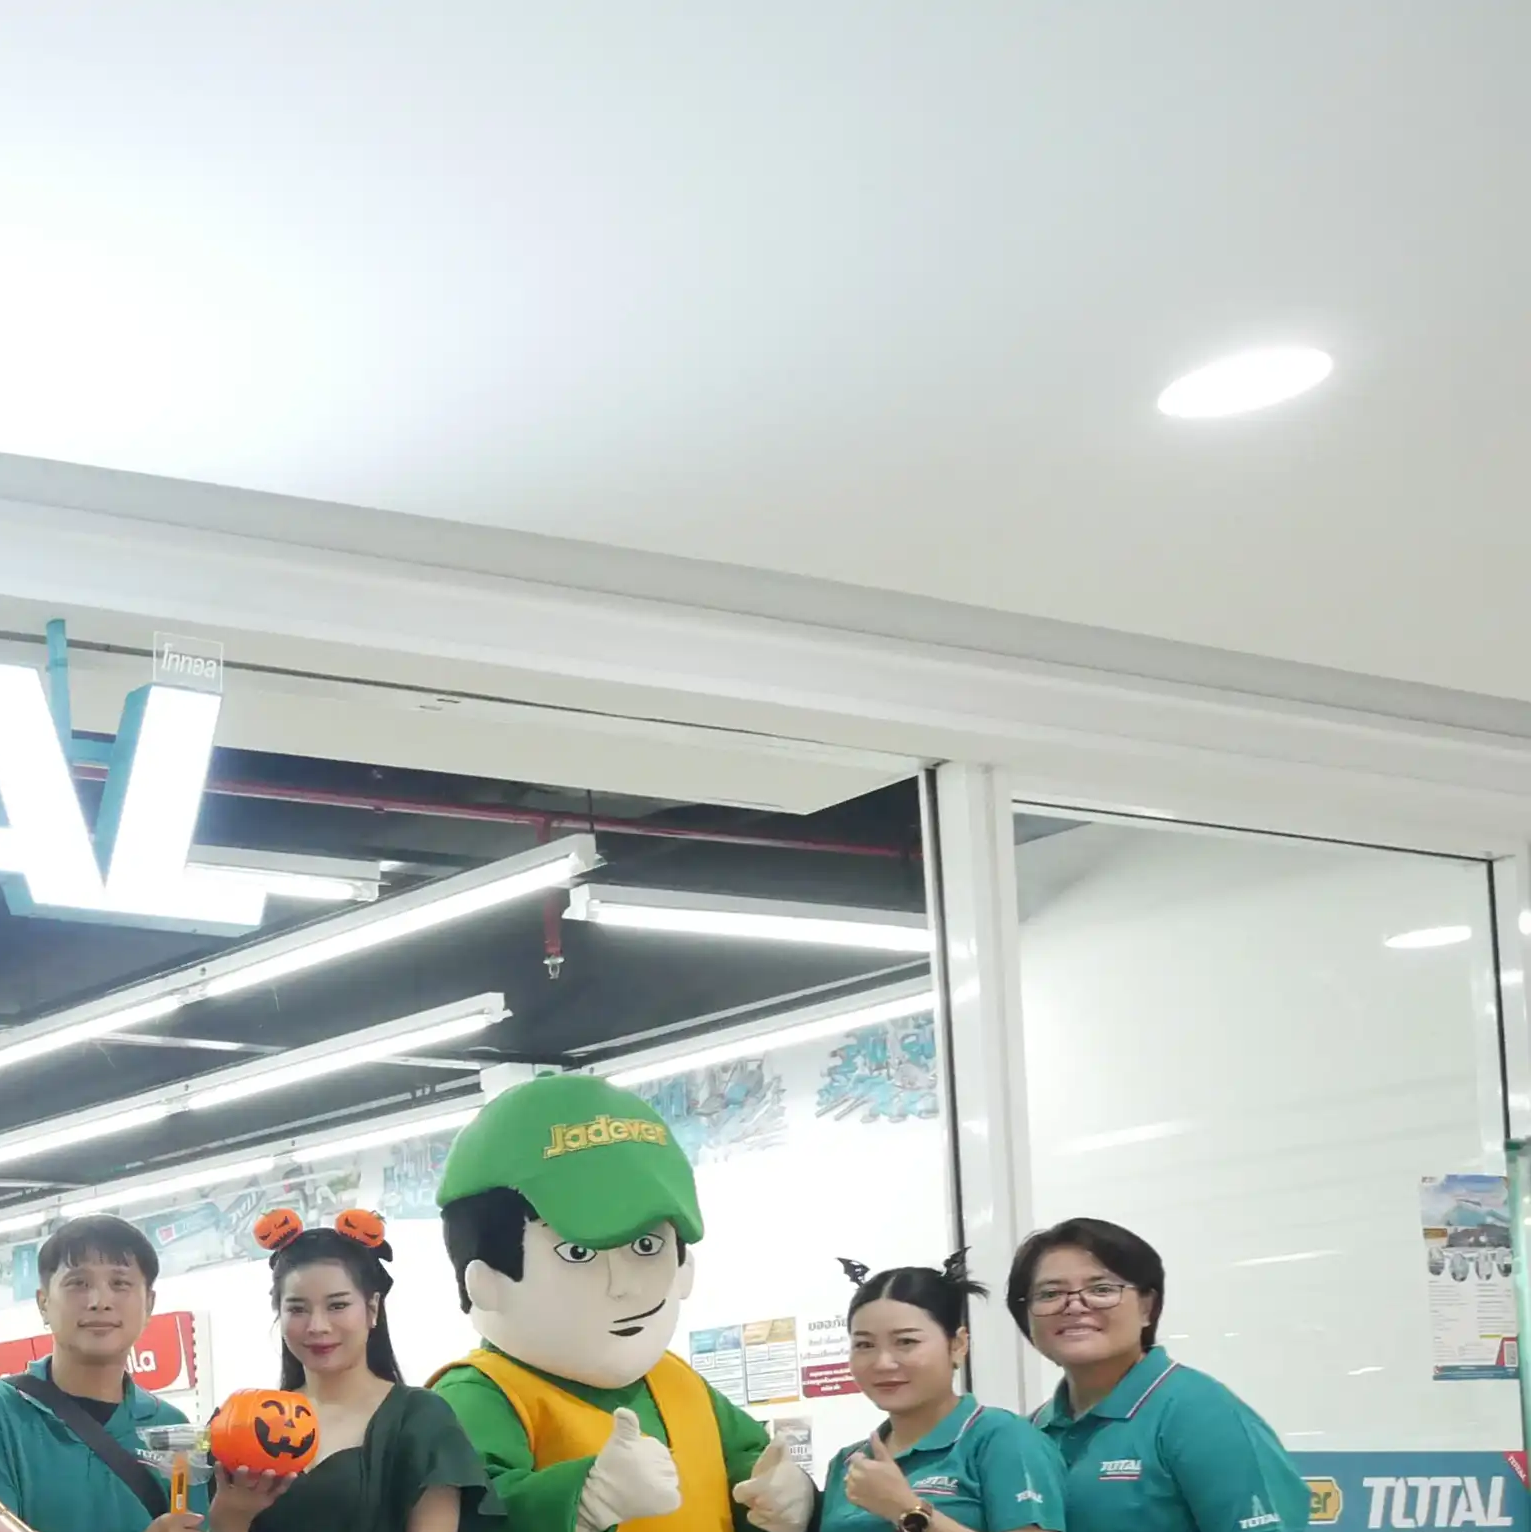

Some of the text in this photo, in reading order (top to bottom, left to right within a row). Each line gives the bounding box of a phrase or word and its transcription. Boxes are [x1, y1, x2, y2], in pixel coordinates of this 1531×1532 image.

[543, 1114, 667, 1159] Jadever
[1100, 1460, 1143, 1472] TOTAL
[1363, 1476, 1513, 1529] TOTAL
